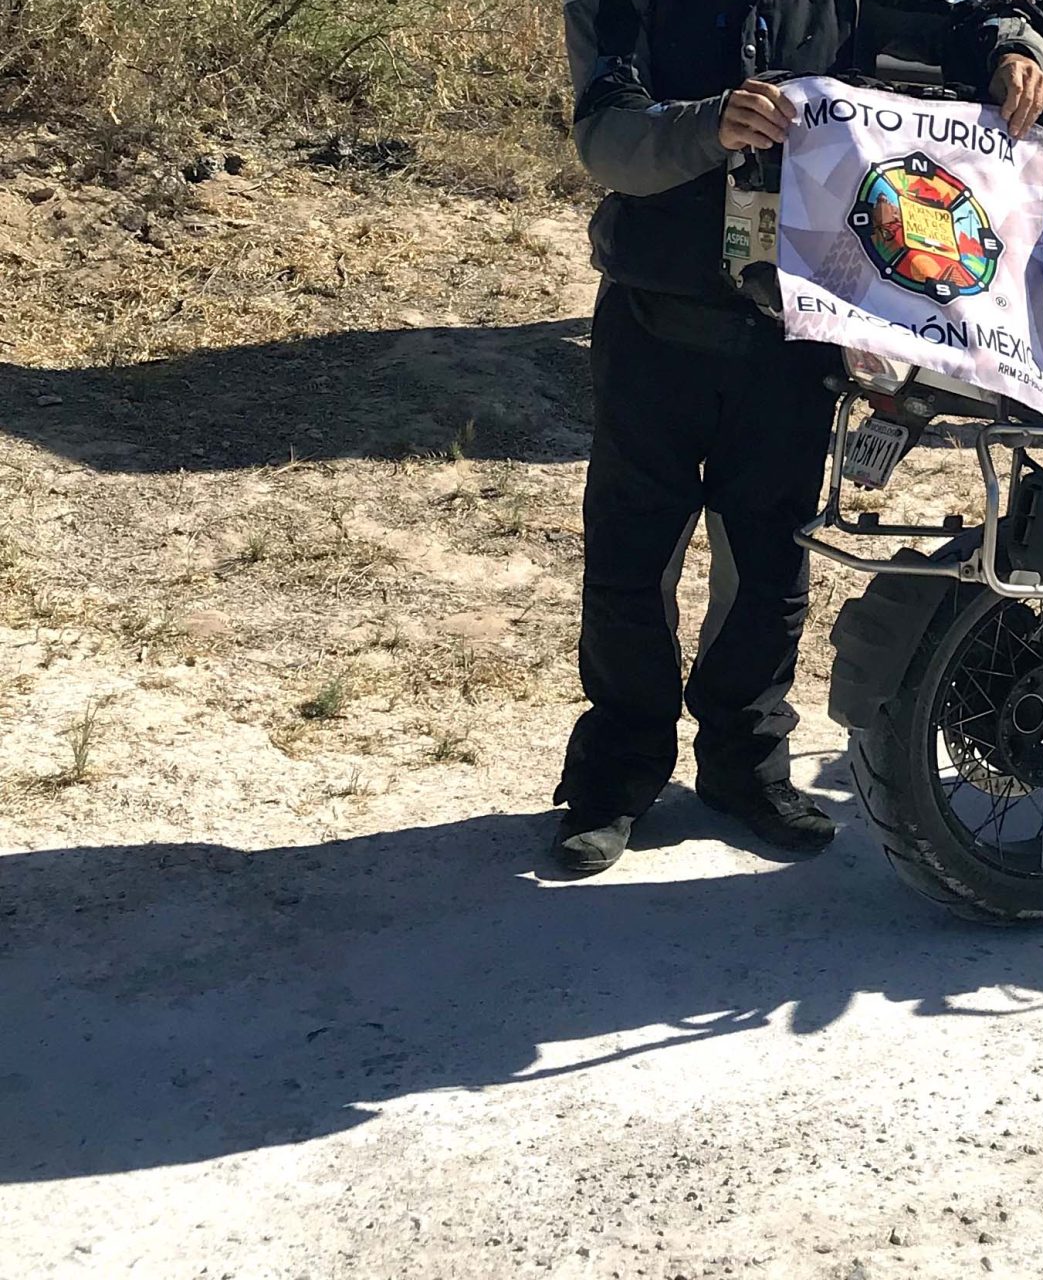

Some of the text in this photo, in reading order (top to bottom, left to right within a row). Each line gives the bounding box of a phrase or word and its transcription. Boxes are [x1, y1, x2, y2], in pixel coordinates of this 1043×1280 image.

[803, 98, 1015, 167] MOTO TURISTA
[911, 158, 928, 173] N
[726, 232, 749, 247] ASPEN
[983, 238, 998, 250] E
[935, 283, 951, 296] S
[797, 295, 837, 315] EN
